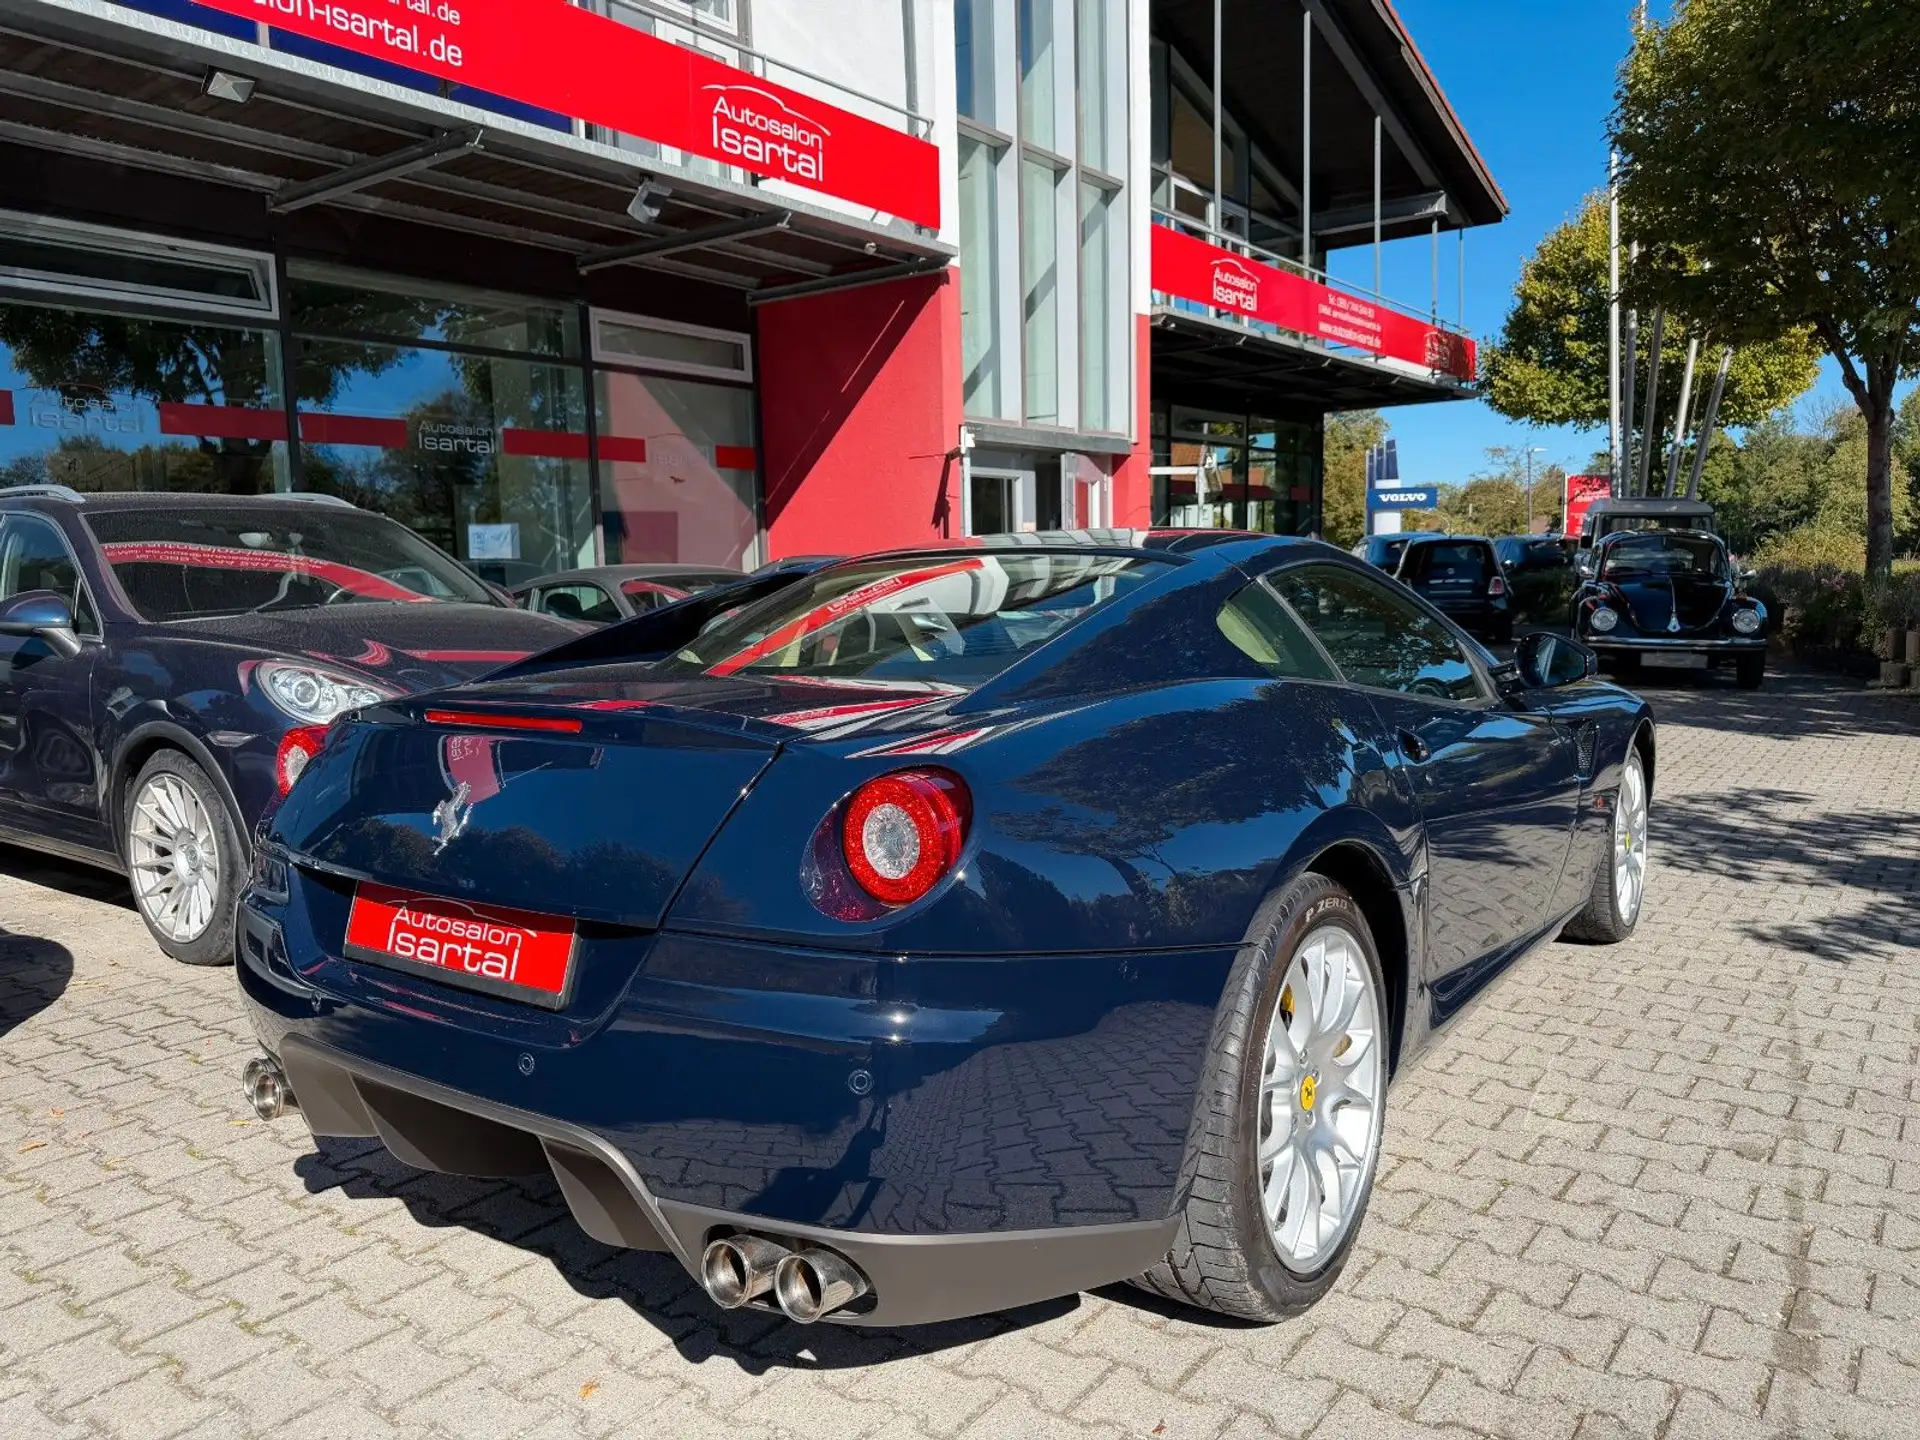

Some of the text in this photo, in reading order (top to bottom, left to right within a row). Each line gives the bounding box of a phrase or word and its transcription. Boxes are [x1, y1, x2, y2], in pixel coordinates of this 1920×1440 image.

[388, 0, 460, 26] tal.de
[253, 0, 463, 67] on-isartal.de
[713, 96, 823, 150] Autosalon
[712, 115, 824, 182] Isartal
[1214, 267, 1257, 292] Autosalon
[1213, 279, 1257, 312] Isartal
[418, 431, 496, 454] Isartal
[419, 420, 494, 437] Autosalon
[1378, 492, 1428, 502] VOLVO
[1317, 897, 1348, 913] ZERO
[393, 906, 522, 949] Autosalon
[387, 921, 520, 981] Isartal
